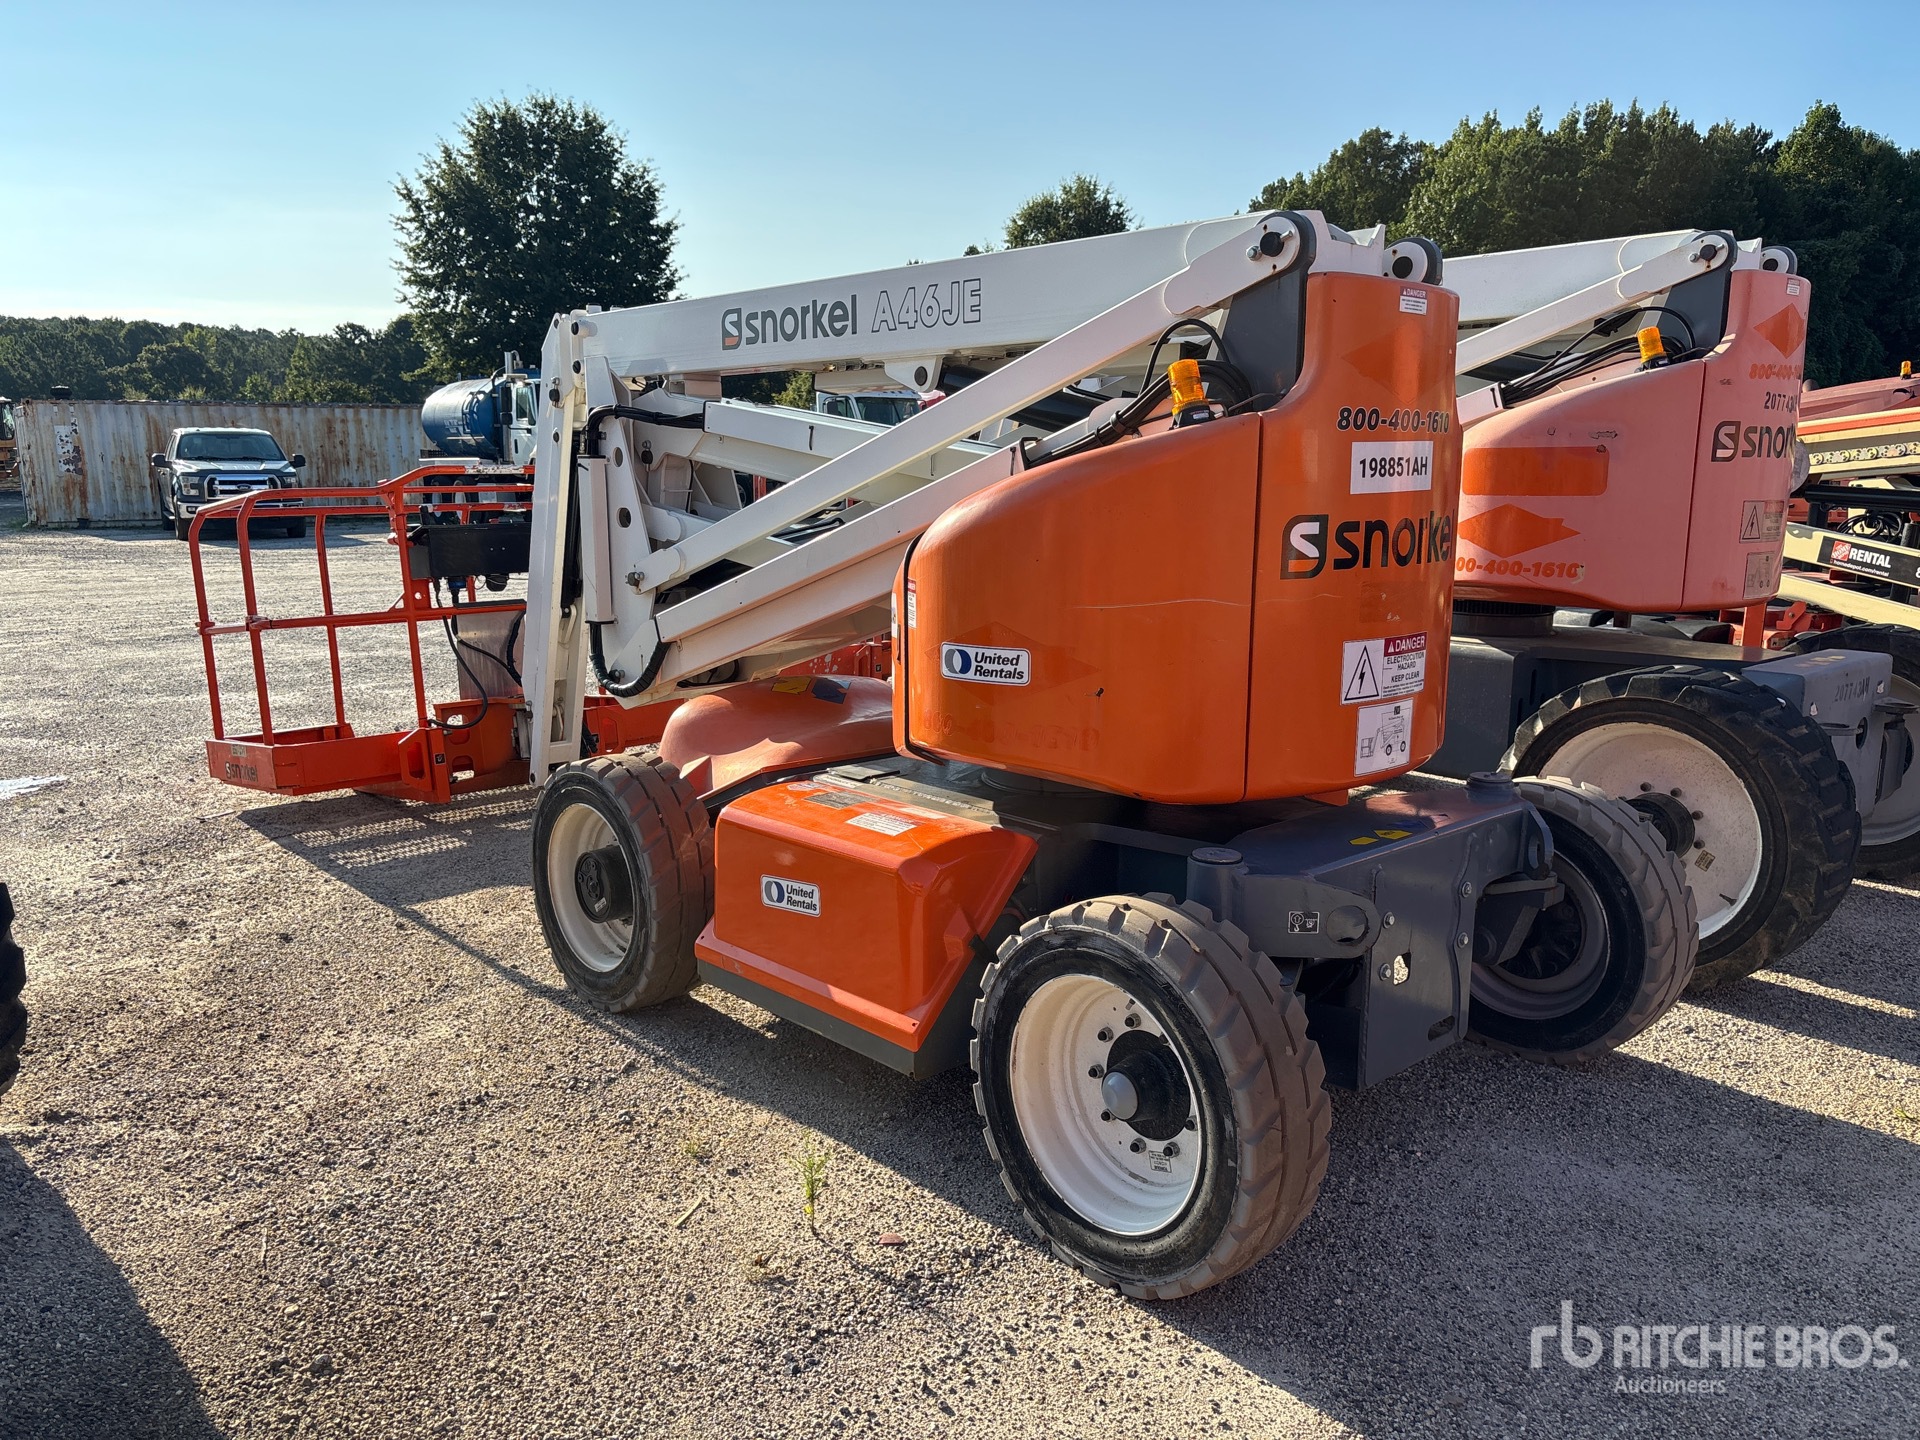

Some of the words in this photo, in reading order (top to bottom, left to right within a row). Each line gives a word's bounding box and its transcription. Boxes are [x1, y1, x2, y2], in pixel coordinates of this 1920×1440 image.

[1406, 288, 1426, 298] DANGER
[745, 294, 858, 345] snorkel
[871, 278, 982, 333] A46JE
[1336, 406, 1450, 433] 800-400-1610
[1359, 456, 1428, 478] 198851AH
[1332, 509, 1455, 571] snorkel
[1848, 547, 1892, 568] RENTAL
[1456, 556, 1581, 578] 00-400-1610
[1395, 636, 1425, 651] DANGER
[974, 651, 1021, 666] United
[1386, 651, 1424, 665] ELECTROCUTION
[973, 664, 1025, 680] Rentals
[1396, 661, 1417, 671] HAZARD
[1391, 673, 1405, 683] KEEP
[1405, 670, 1420, 681] CLEAR
[786, 884, 814, 899] United
[786, 896, 818, 911] Rentals
